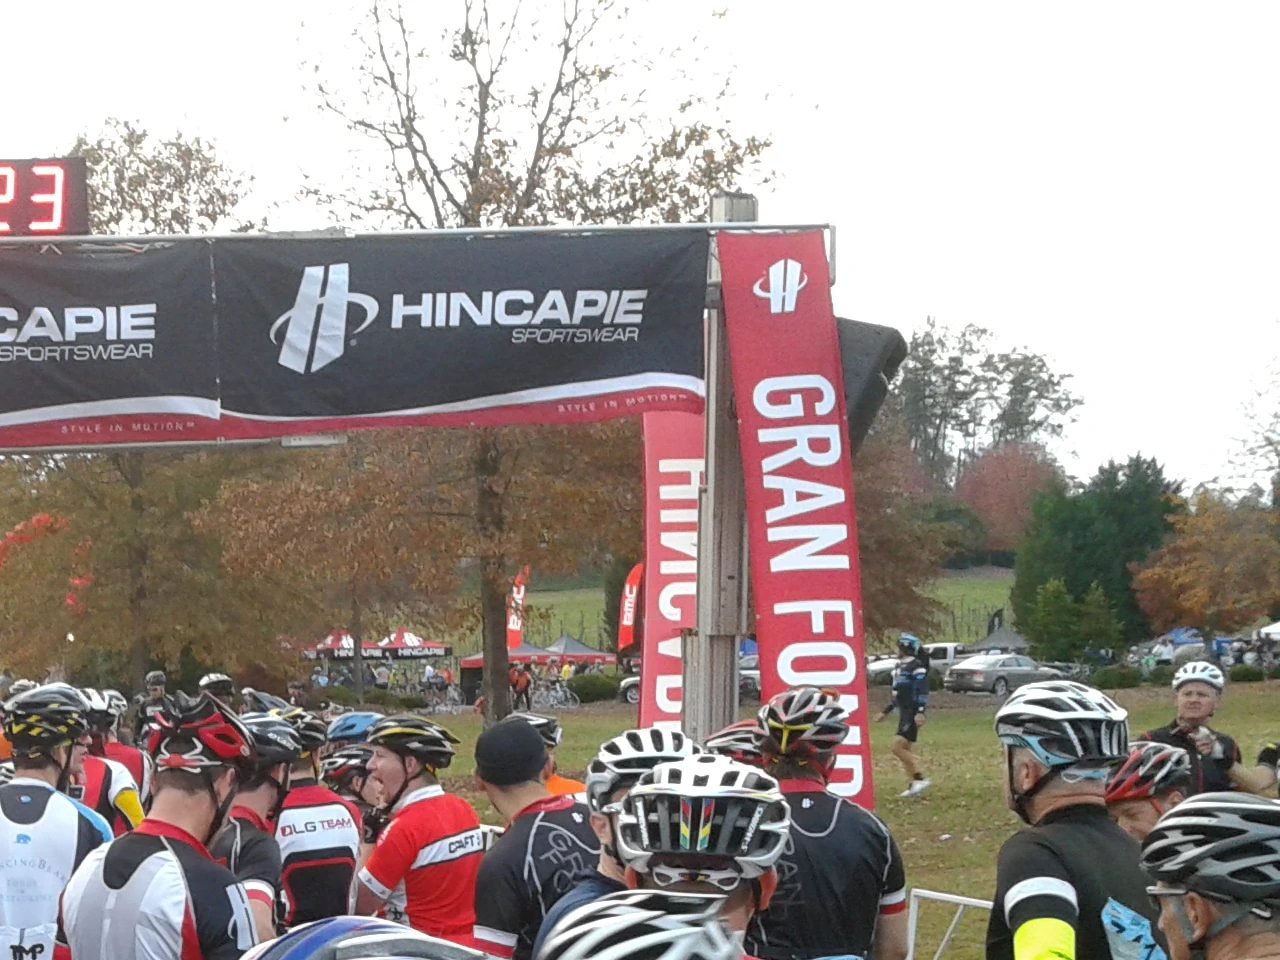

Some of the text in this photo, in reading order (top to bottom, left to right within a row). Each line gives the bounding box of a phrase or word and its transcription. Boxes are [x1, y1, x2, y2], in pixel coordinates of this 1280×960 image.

[391, 289, 648, 330] HINCAPIE
[511, 327, 639, 345] SPORTSWEAR
[752, 373, 851, 573] GRAN
[319, 817, 353, 831] TEAM
